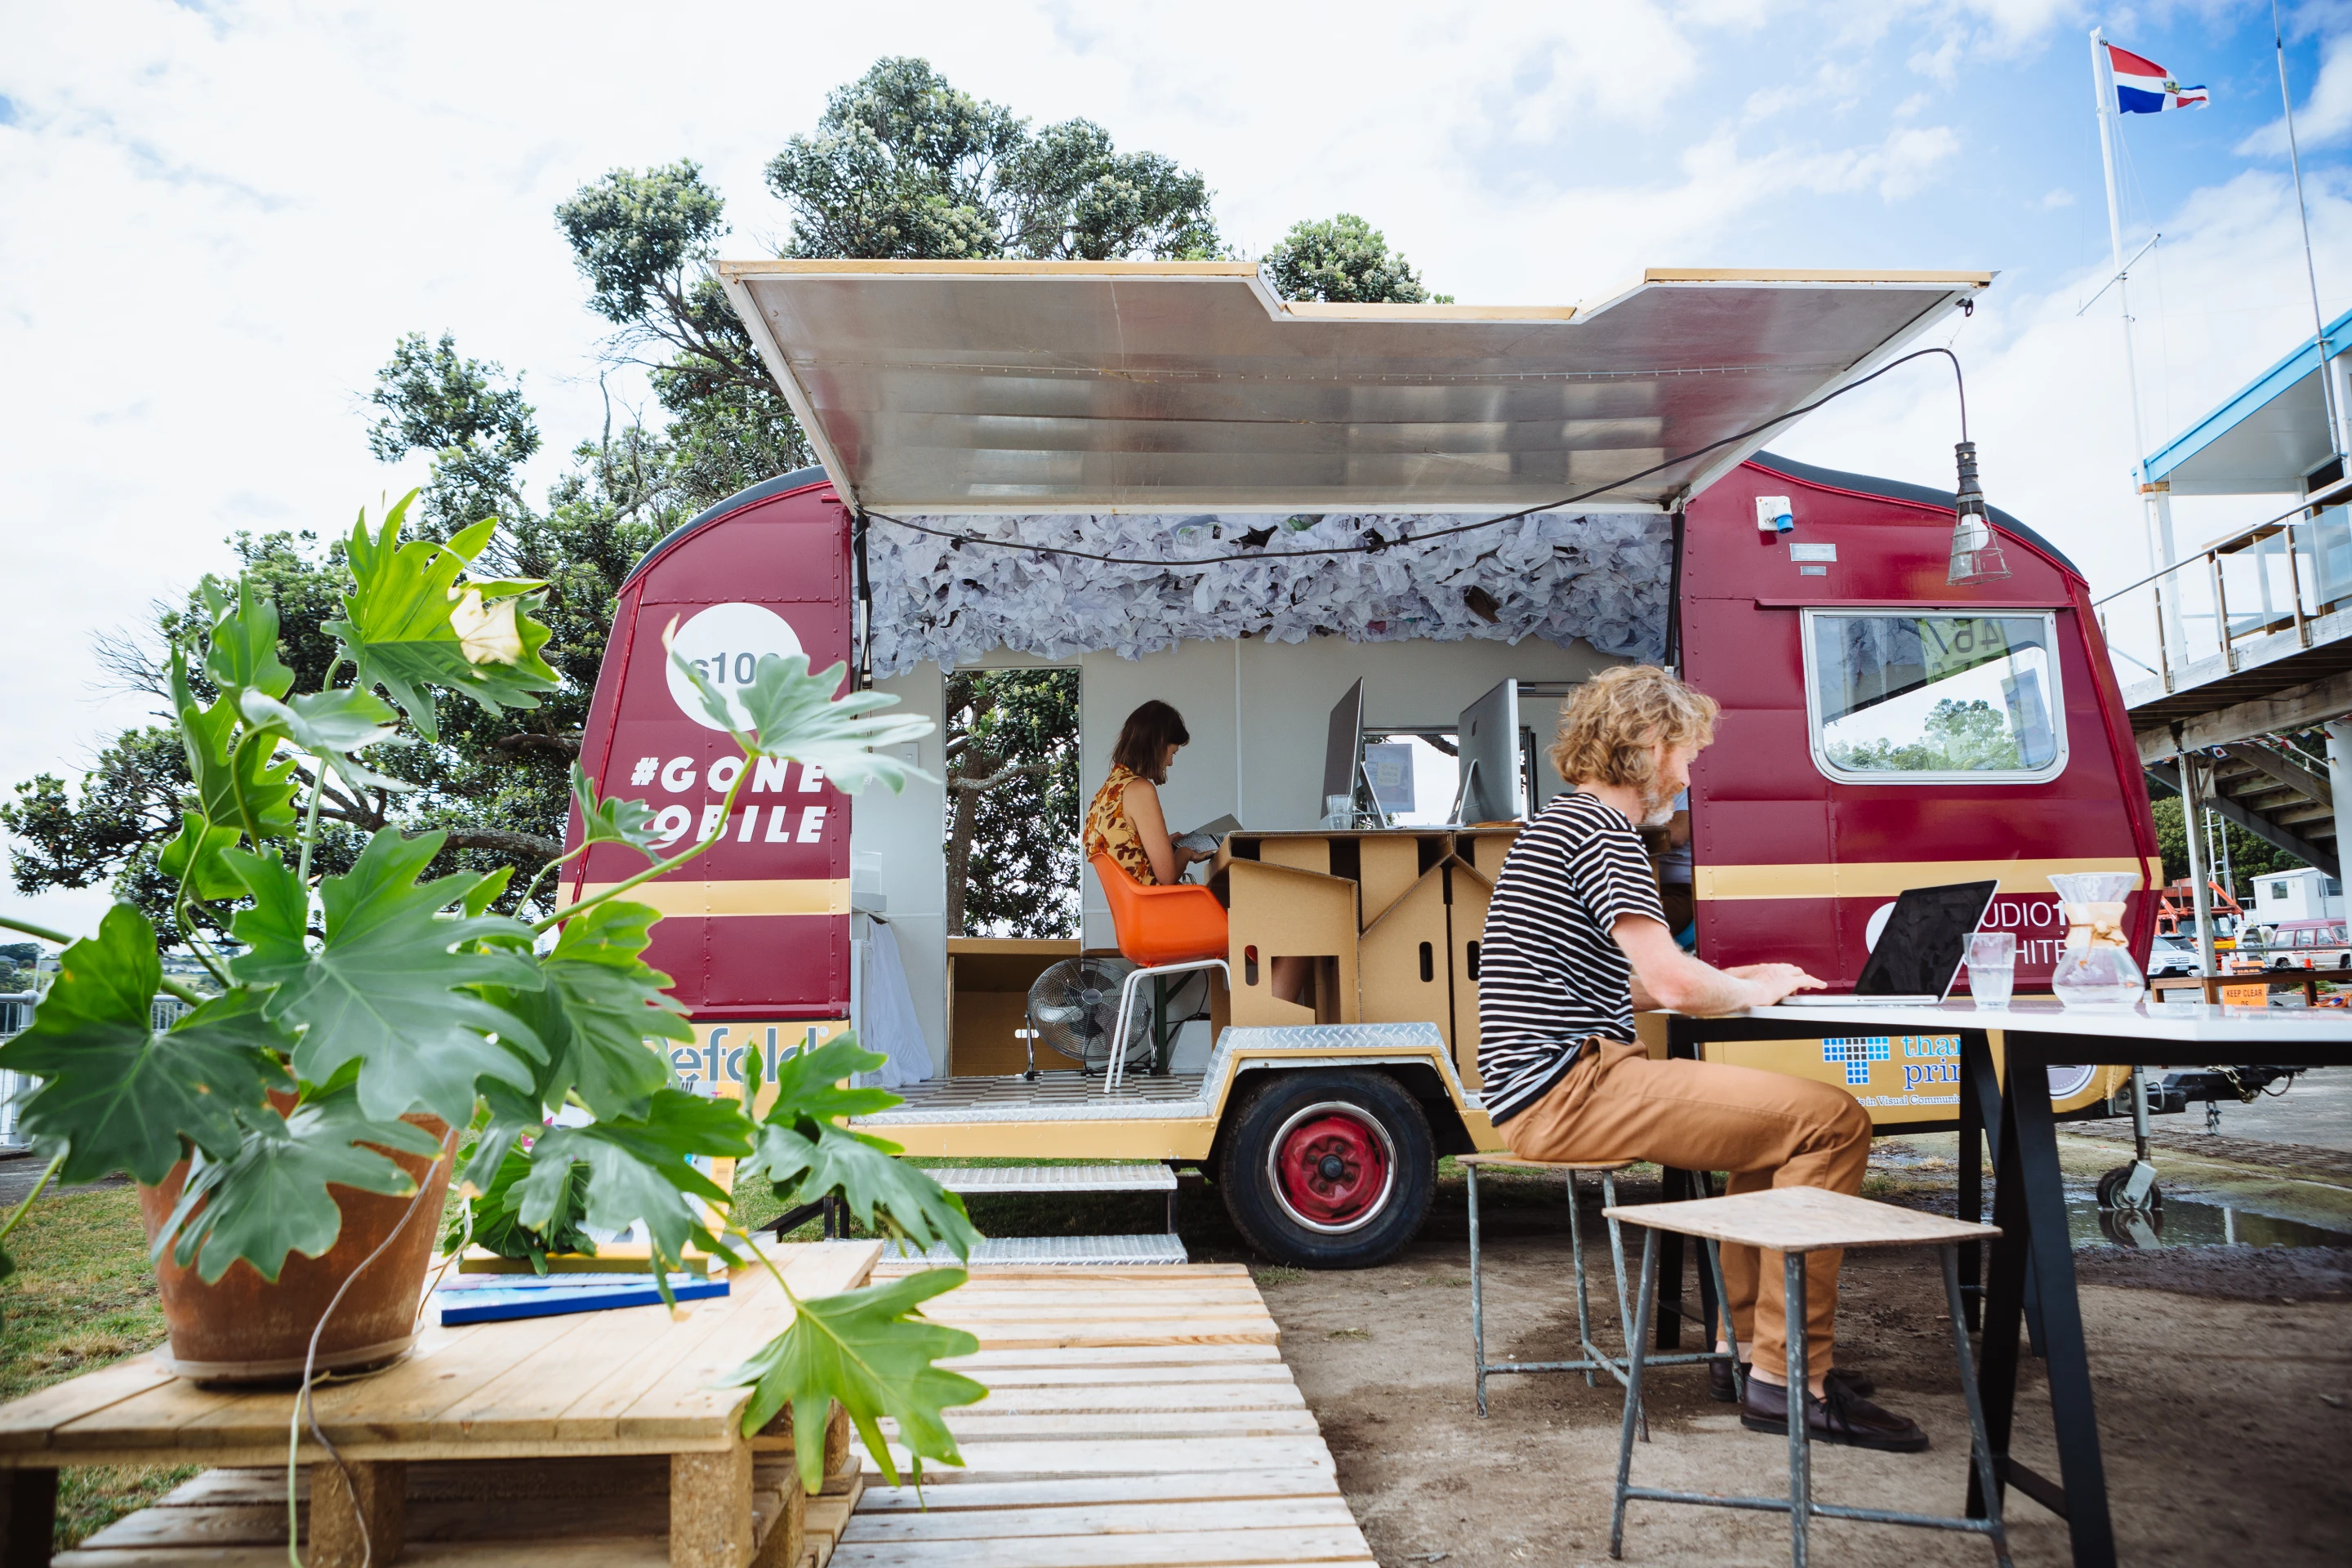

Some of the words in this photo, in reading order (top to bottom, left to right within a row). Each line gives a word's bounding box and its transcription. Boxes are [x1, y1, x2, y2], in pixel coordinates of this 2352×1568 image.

[688, 652, 781, 684] s10
[630, 755, 825, 793] #GONE
[639, 804, 827, 843] OBILE
[2226, 989, 2241, 998] KEEP
[2243, 989, 2262, 997] CLEAR
[642, 1026, 817, 1084] efold
[1867, 1096, 1877, 1106] in
[1878, 1095, 1908, 1105] Visual
